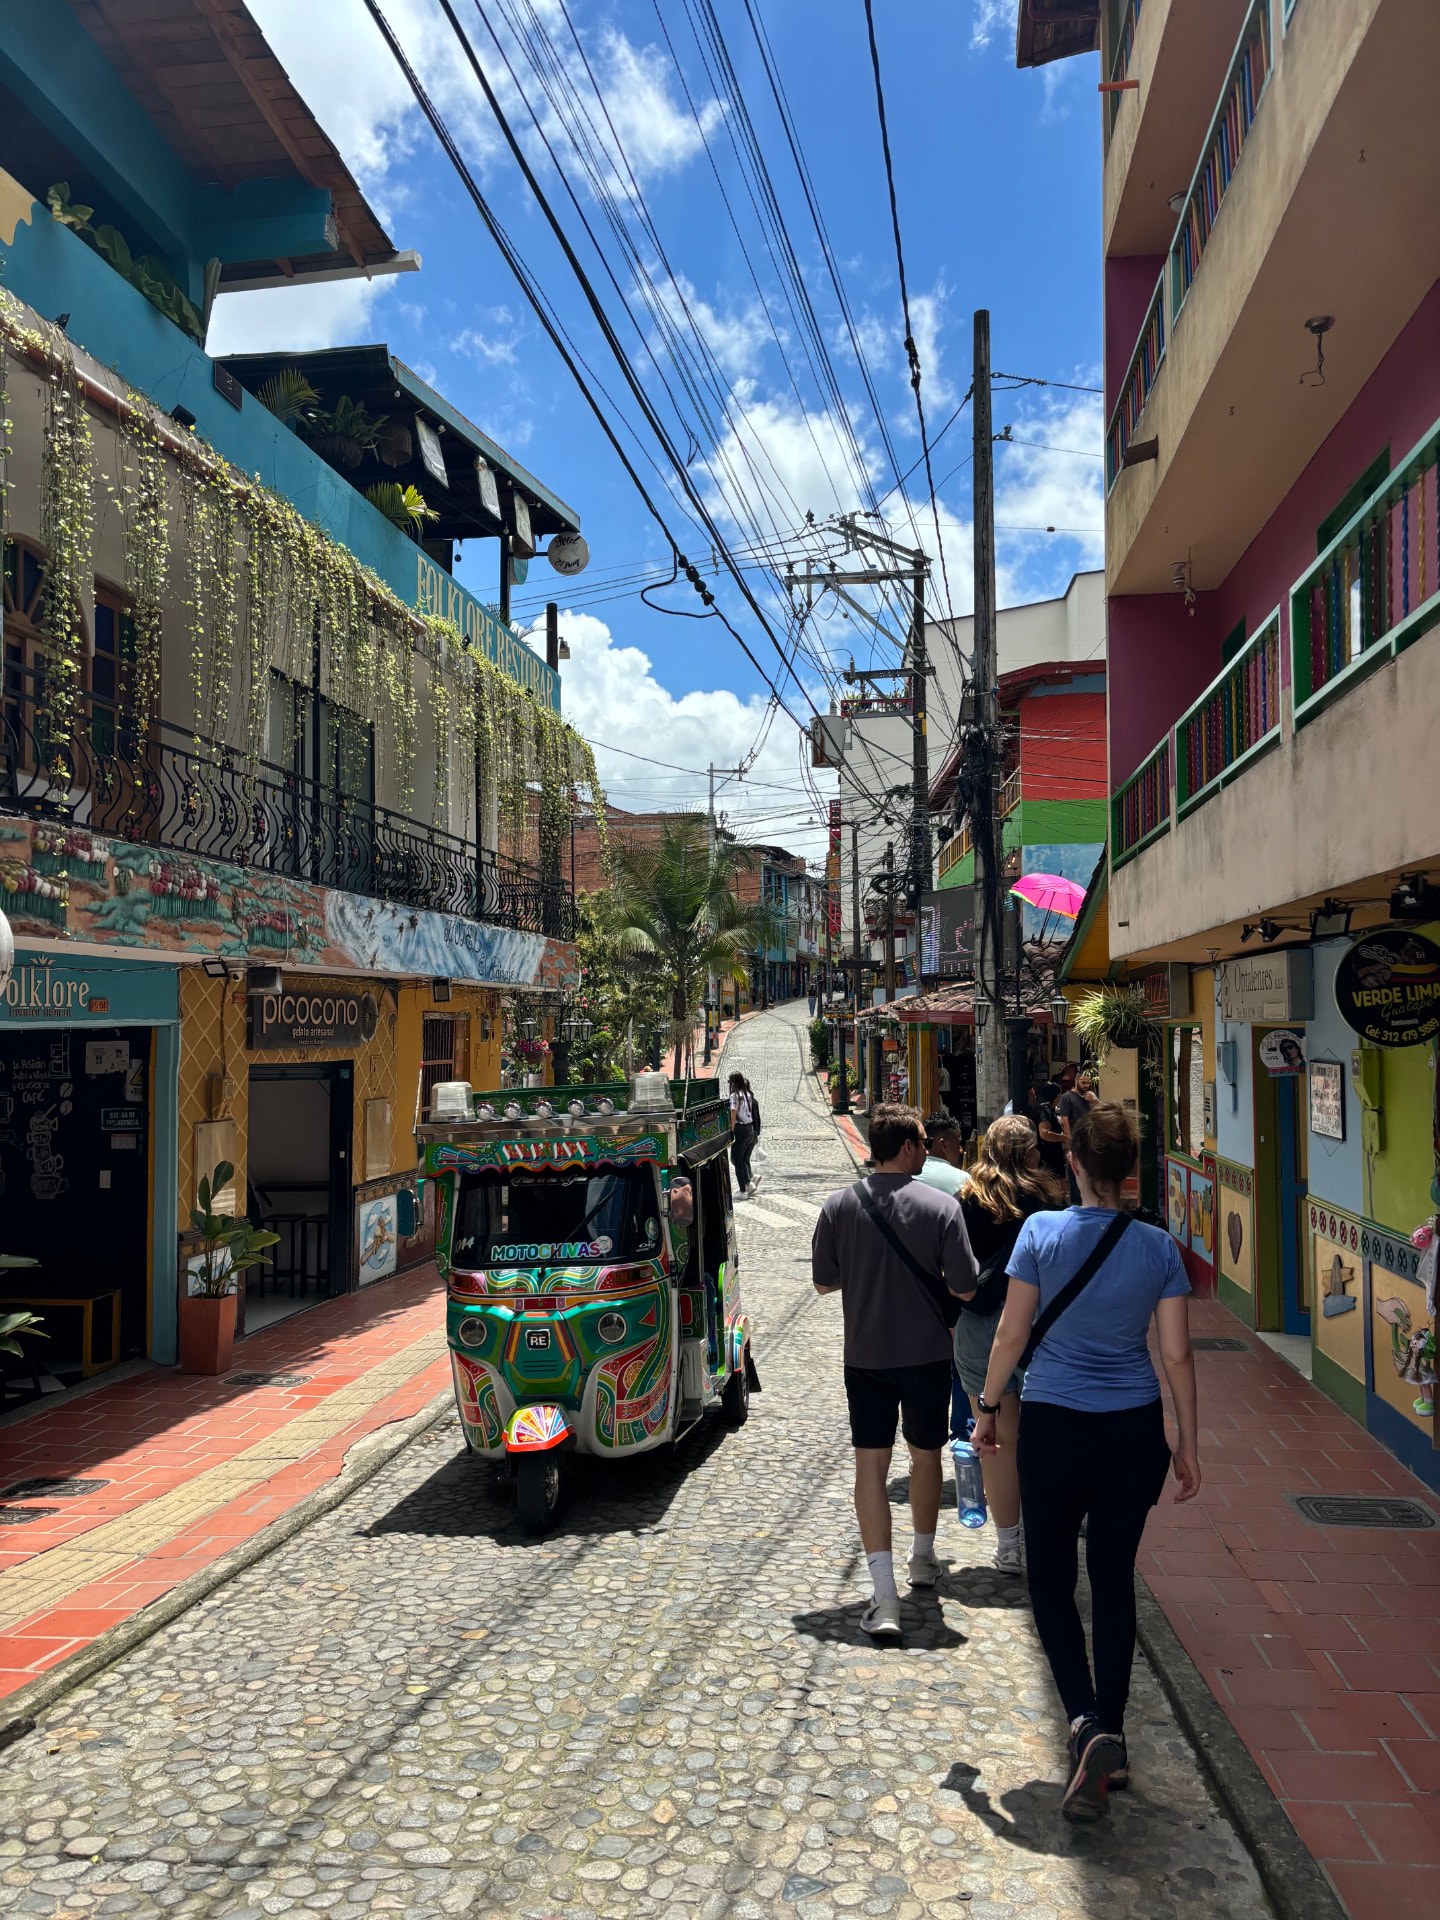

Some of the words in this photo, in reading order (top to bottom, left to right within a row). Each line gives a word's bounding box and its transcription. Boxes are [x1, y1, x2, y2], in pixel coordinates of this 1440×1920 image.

[416, 553, 494, 664] FOLKLORE
[496, 625, 554, 711] RESTOBAR
[0, 966, 90, 1007] olklore
[1144, 972, 1169, 1003] PIZZA
[1352, 986, 1403, 1008] VERDE
[1406, 982, 1440, 1002] LIMA
[262, 994, 358, 1034] picocono
[292, 1026, 310, 1039] gelato
[310, 1026, 335, 1037] artesanal
[1365, 1024, 1381, 1039] Cel:
[1381, 1030, 1399, 1042] 312
[1401, 1029, 1418, 1041] 479
[1417, 1017, 1440, 1037] 5889
[490, 1241, 602, 1262] MOTOCHIVAS
[530, 1336, 547, 1346] RE
